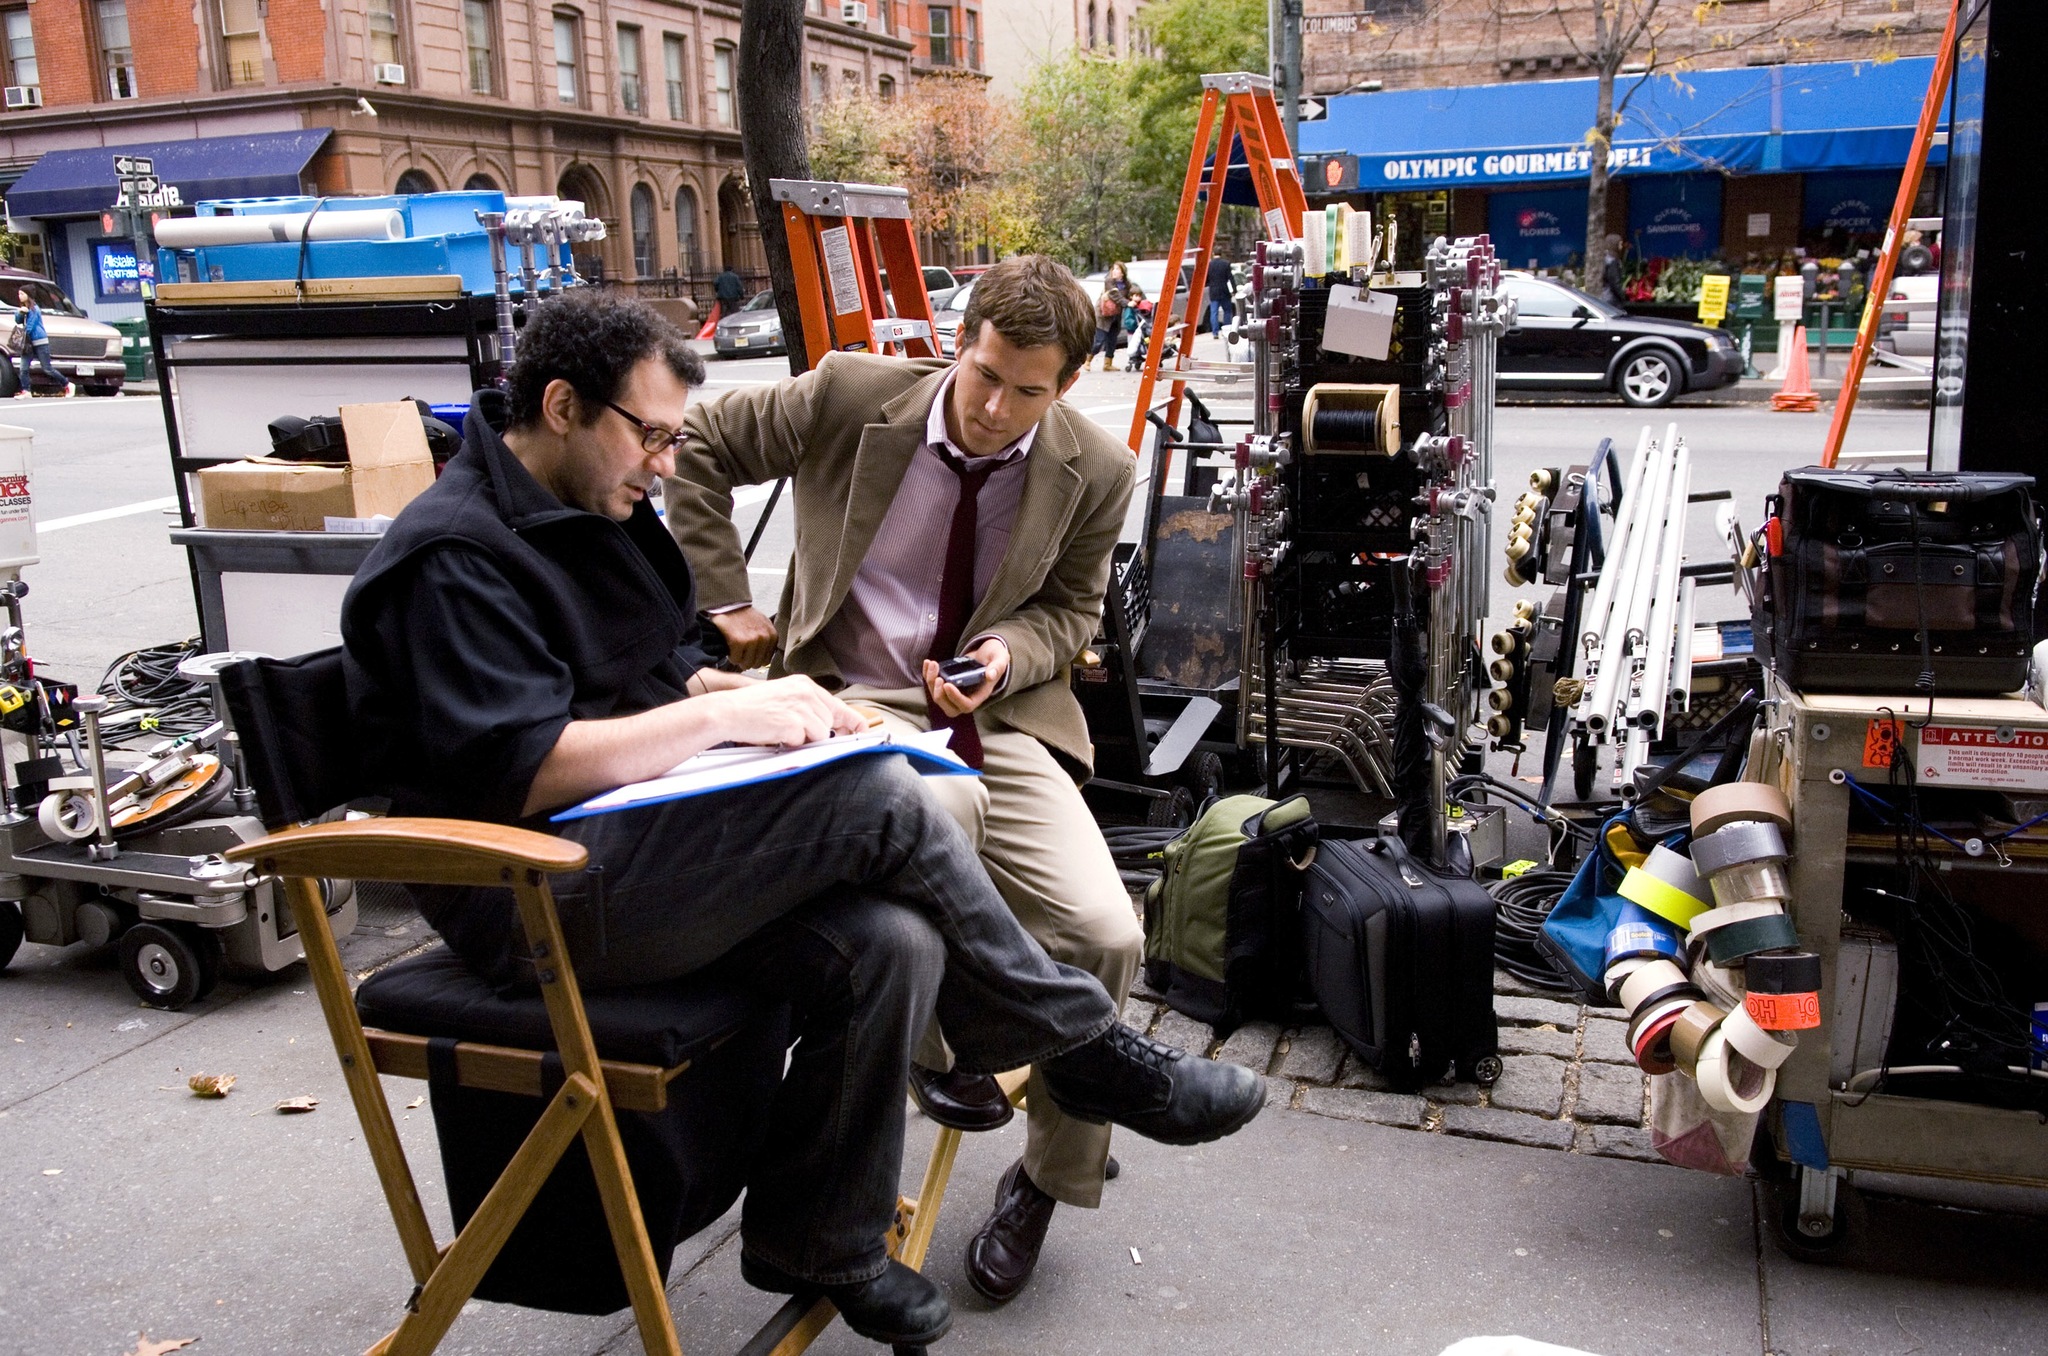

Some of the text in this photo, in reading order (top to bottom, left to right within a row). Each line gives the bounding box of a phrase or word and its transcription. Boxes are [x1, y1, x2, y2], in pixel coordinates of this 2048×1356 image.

[1303, 17, 1358, 33] COLUMBUS
[120, 162, 132, 170] ONE
[1383, 156, 1477, 180] OLYMPIC
[1483, 151, 1592, 175] GOURMET
[1654, 207, 1692, 222] OLYMPIC
[1519, 227, 1561, 237] FLOWERS
[1646, 223, 1701, 234] SANDWICHES
[220, 492, 292, 518] License
[1949, 731, 2045, 746] ATTETIO
[1980, 750, 2006, 758] designed
